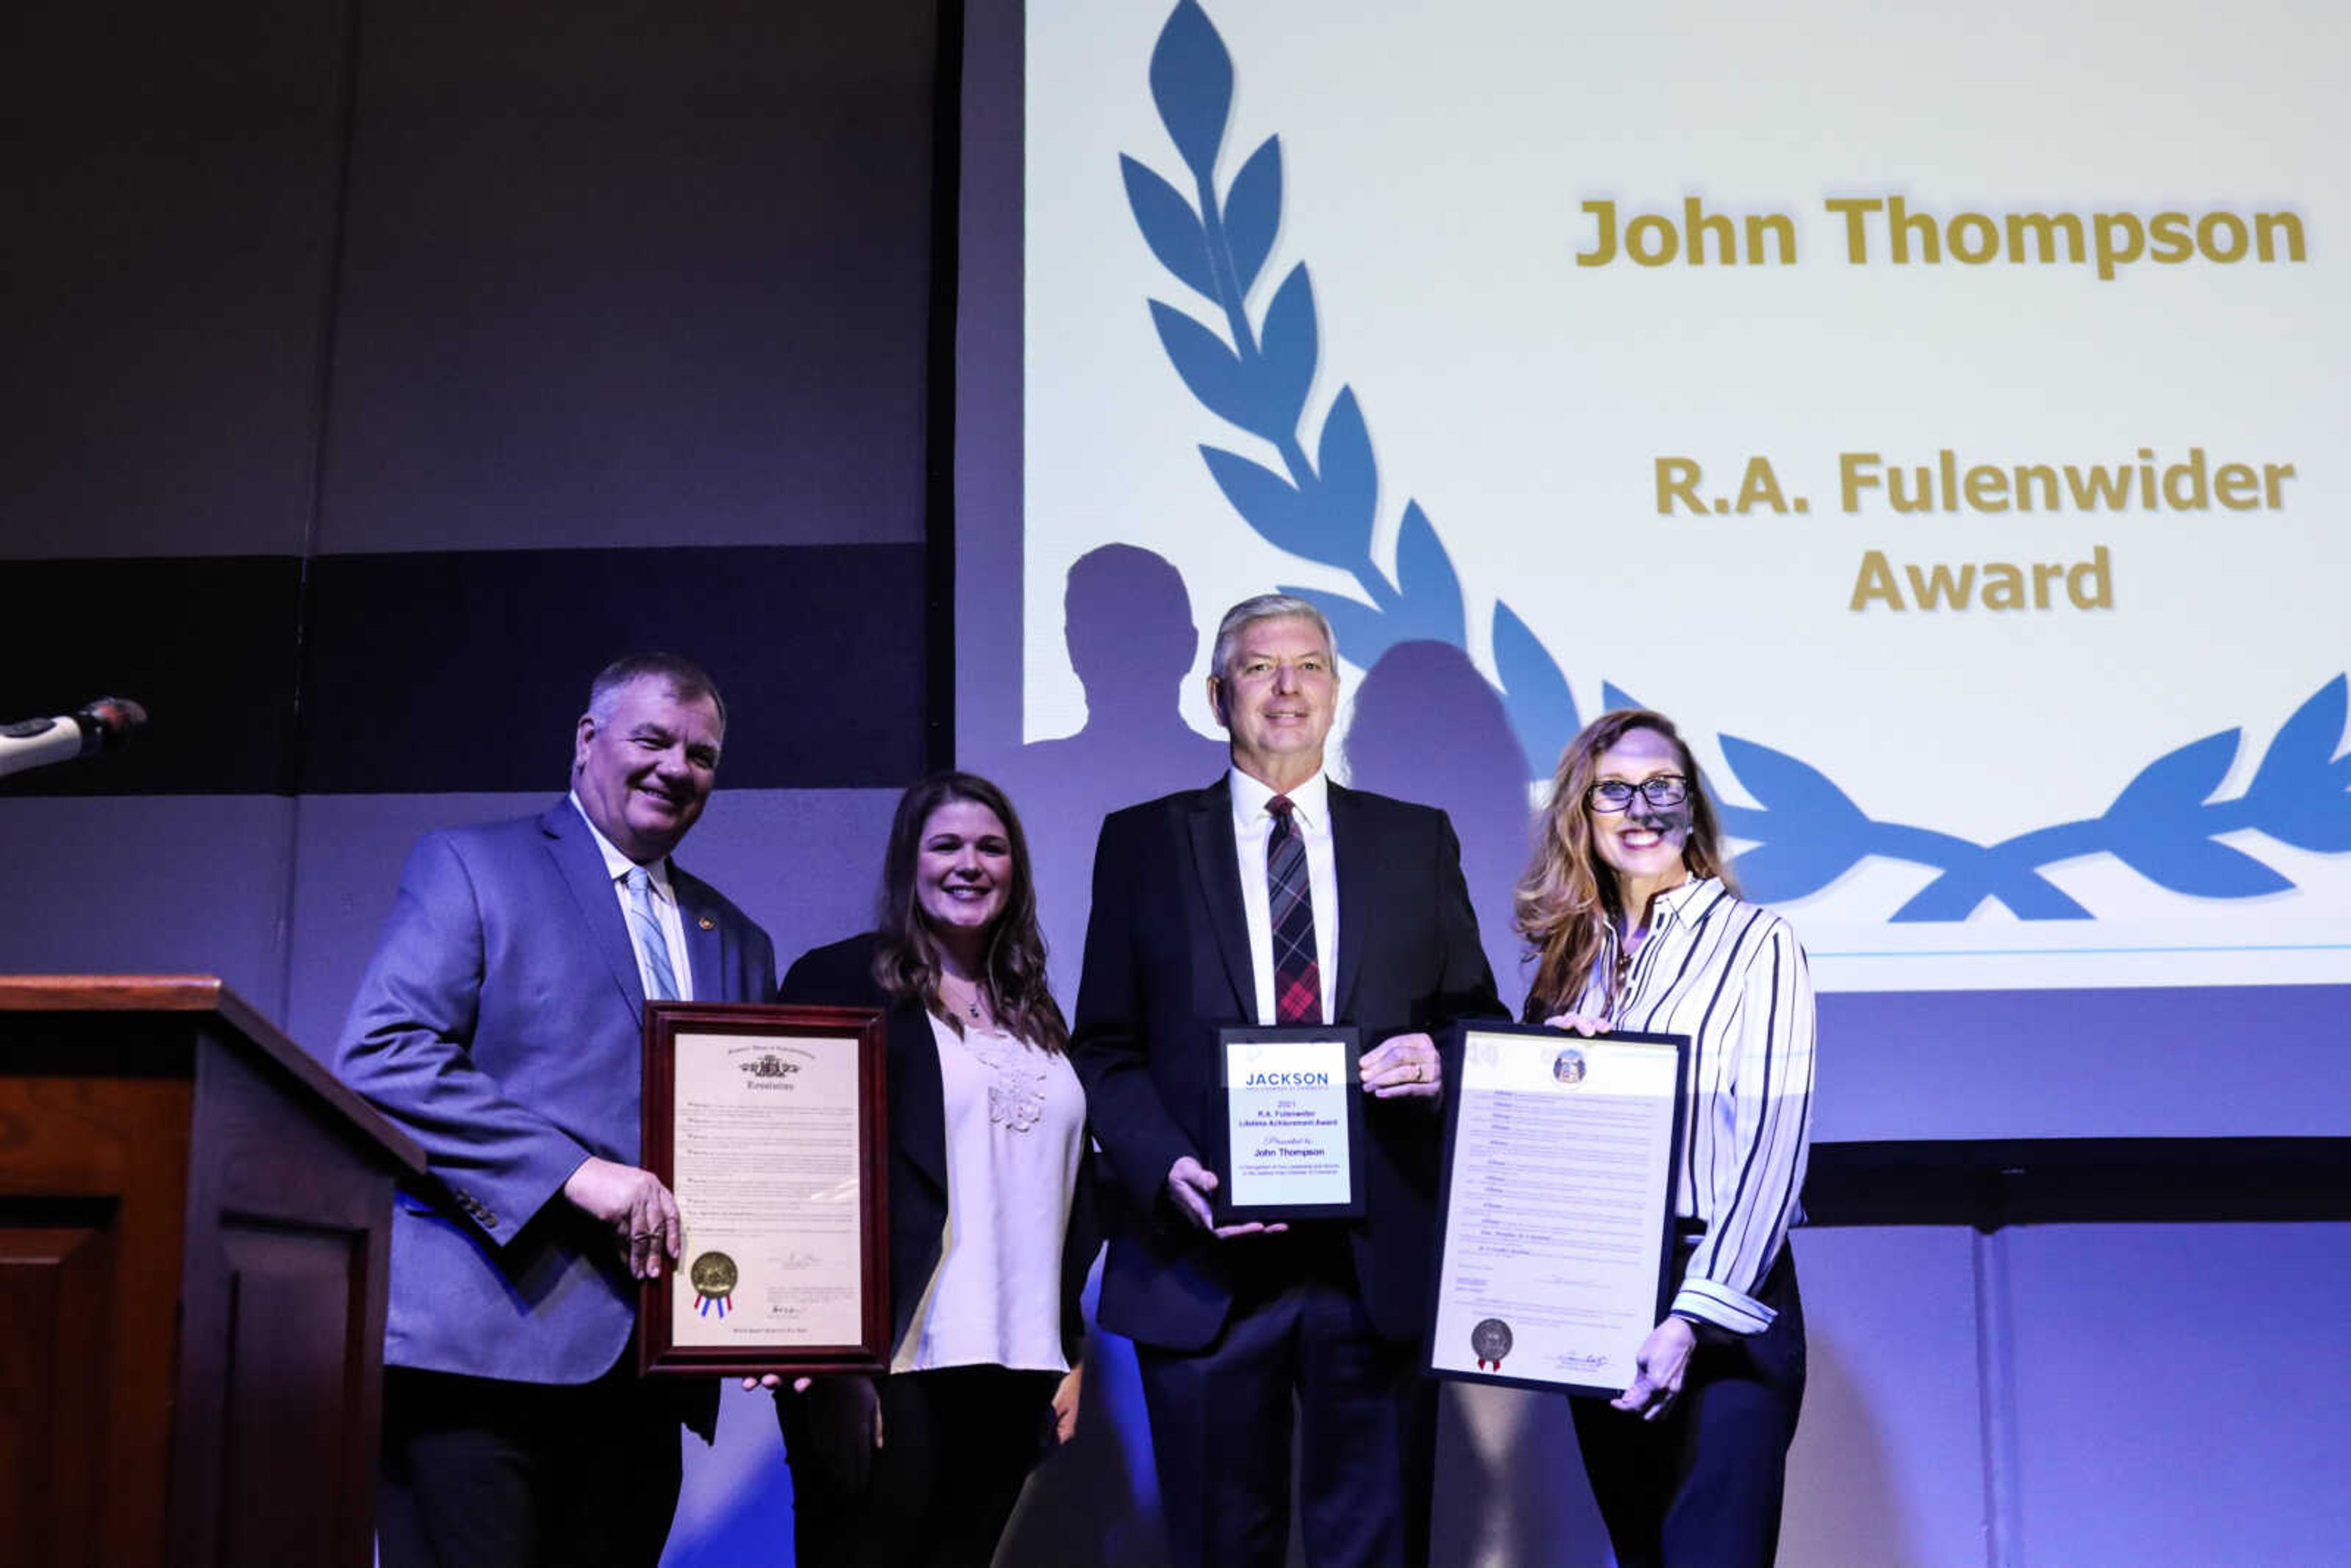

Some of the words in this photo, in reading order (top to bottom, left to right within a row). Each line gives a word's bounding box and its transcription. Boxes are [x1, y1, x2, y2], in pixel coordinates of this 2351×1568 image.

[1576, 196, 1796, 268] John
[1825, 195, 2306, 281] Thompson
[1655, 457, 1808, 514] R.A.
[1840, 447, 2295, 513] Fulenwider
[1850, 546, 2113, 611] Award
[1246, 1072, 1329, 1086] JACKSON
[1254, 1148, 1276, 1157] John
[1279, 1148, 1325, 1158] Thompson
